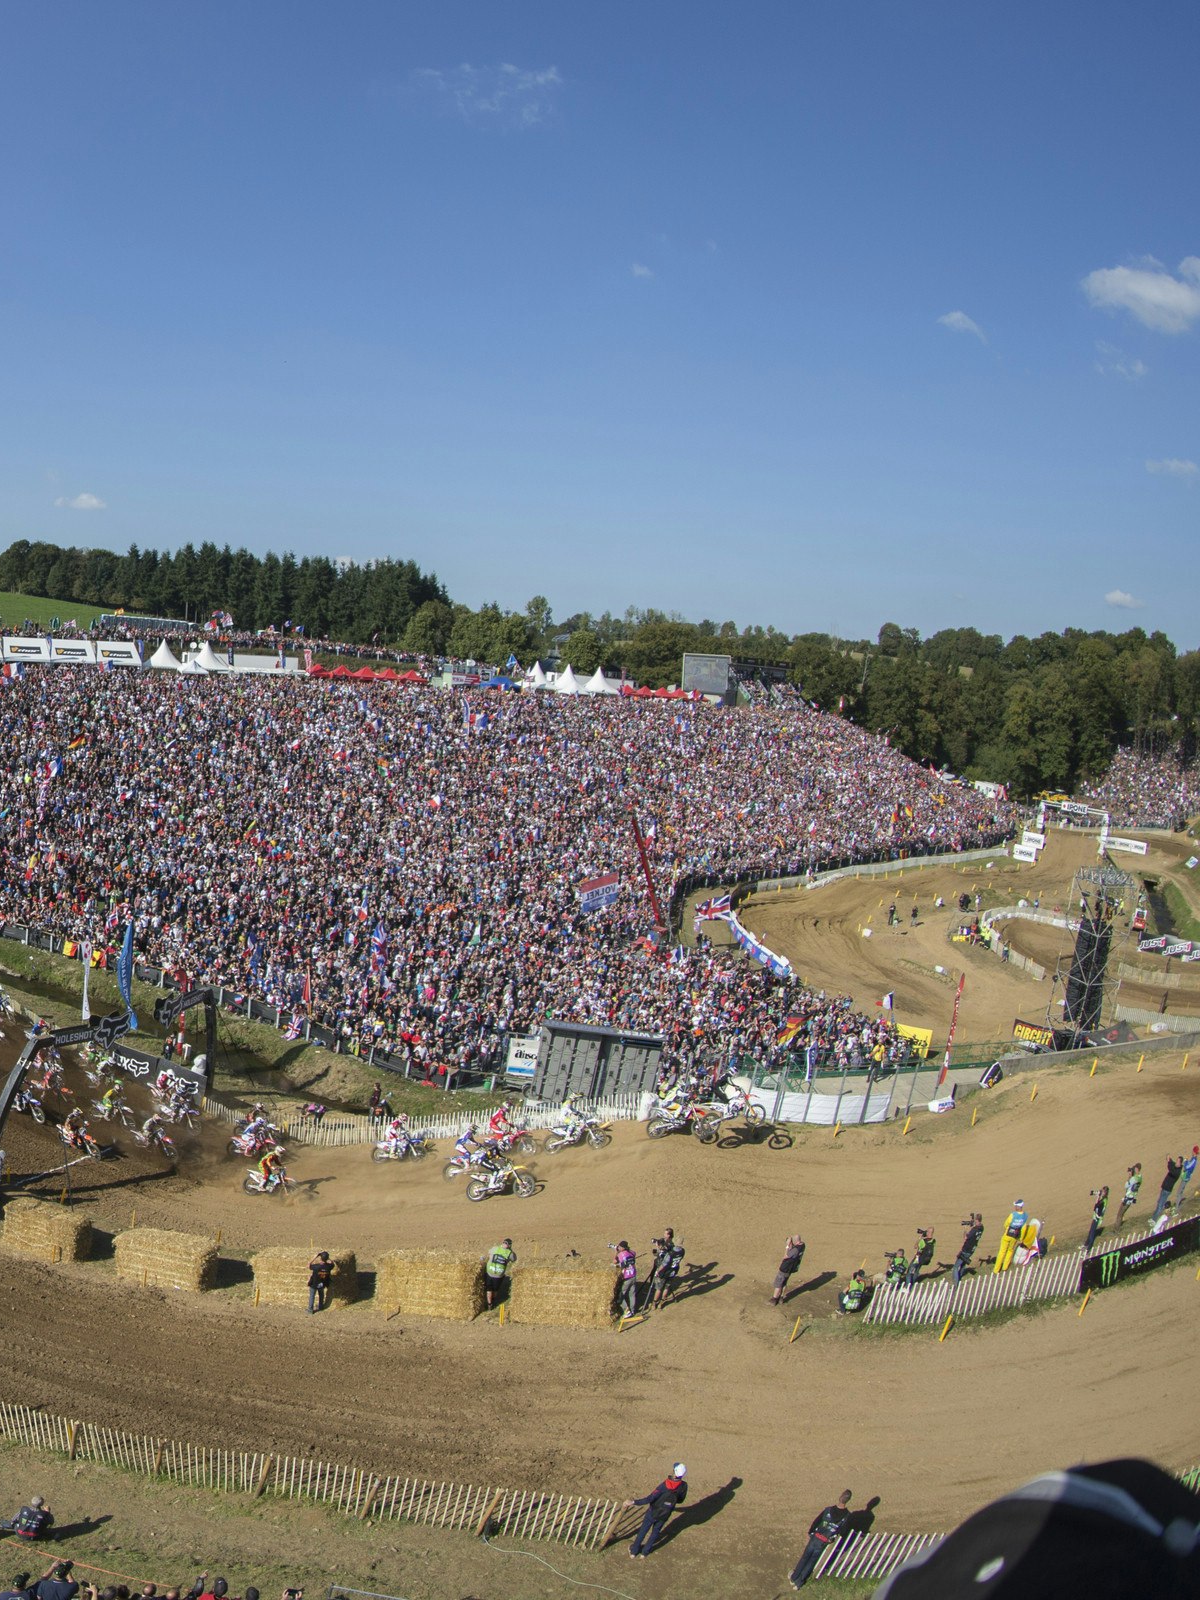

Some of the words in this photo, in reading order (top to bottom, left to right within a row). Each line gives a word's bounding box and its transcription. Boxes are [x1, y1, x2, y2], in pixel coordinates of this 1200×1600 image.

[1067, 804, 1087, 812] IPONE
[55, 1030, 93, 1045] HOLESHOT
[1013, 1024, 1053, 1046] CIRCUIT
[1124, 1237, 1174, 1265] MONSTER
